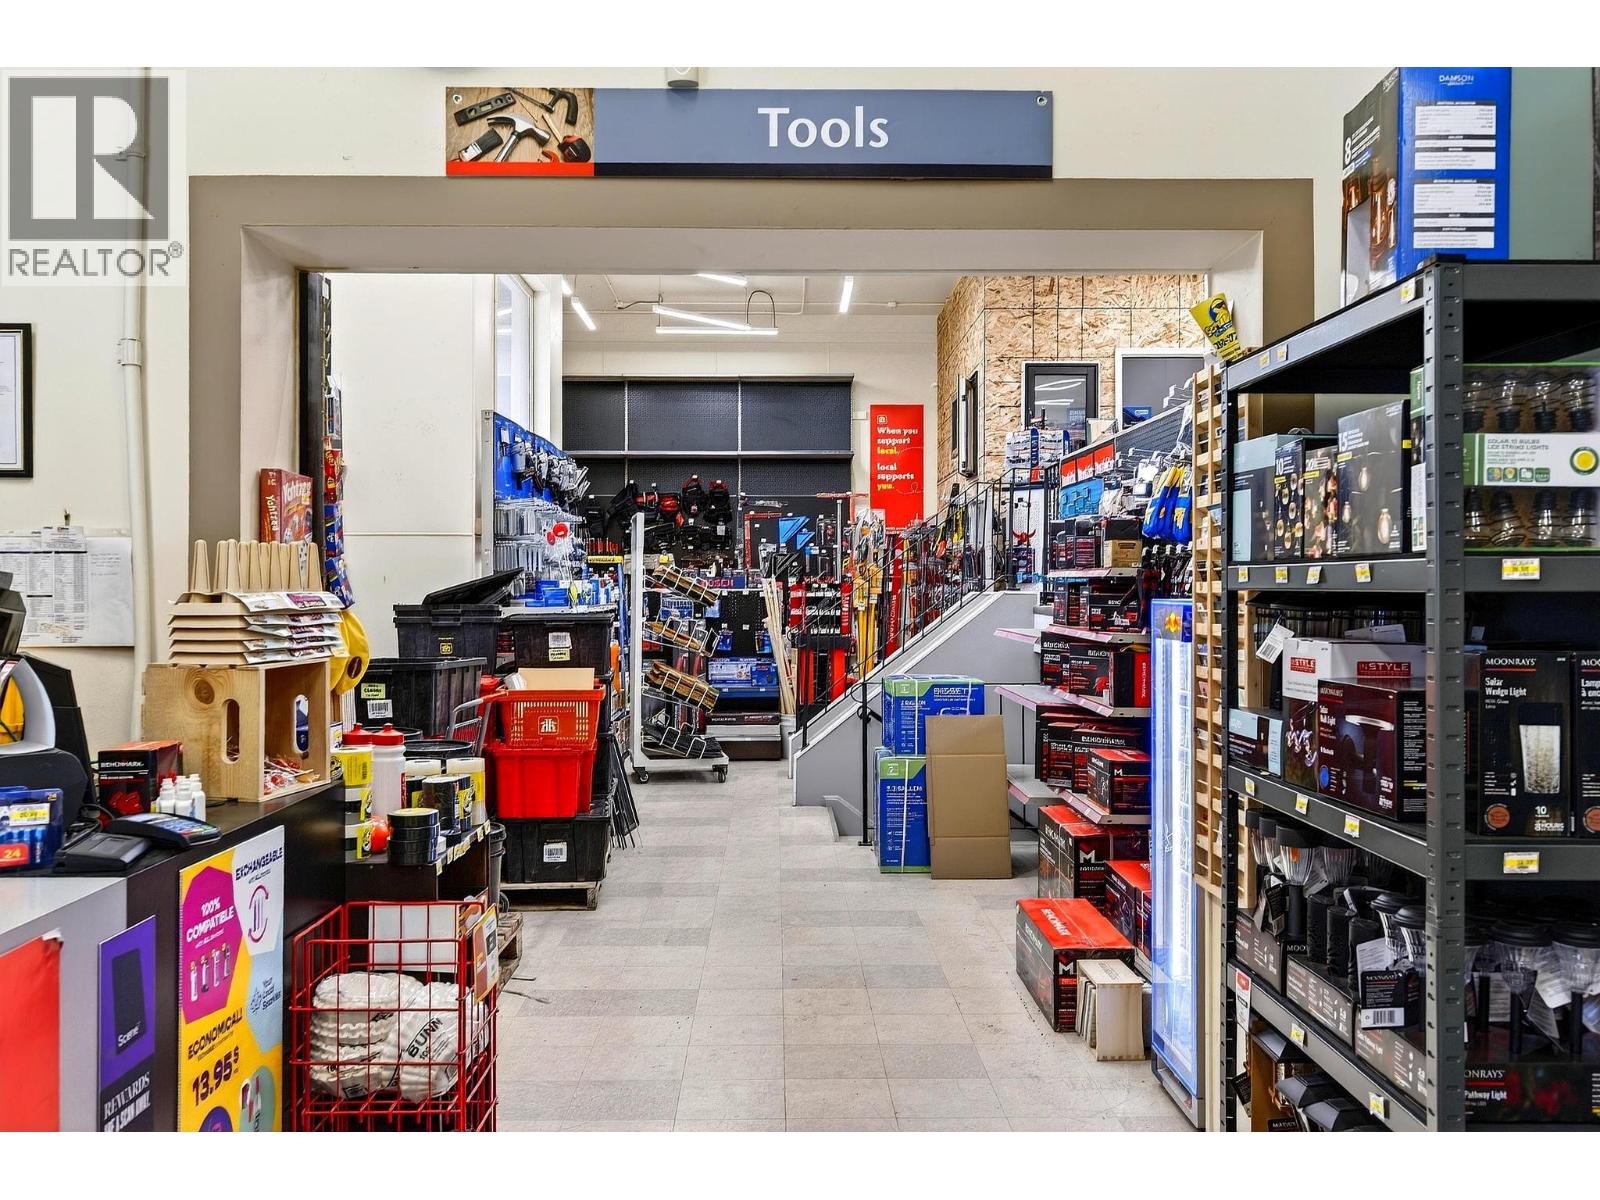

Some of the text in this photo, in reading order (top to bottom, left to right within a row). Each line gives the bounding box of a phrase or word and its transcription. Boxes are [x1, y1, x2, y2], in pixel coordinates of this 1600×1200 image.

[1439, 75, 1474, 83] DAMSON
[757, 106, 890, 148] Tools
[1344, 137, 1352, 165] 8
[877, 427, 901, 435] When
[877, 437, 910, 446] support
[877, 463, 897, 471] local
[877, 473, 914, 481] supports
[1360, 662, 1409, 671] INSTYLE
[1485, 658, 1536, 666] MOONRAYS
[1485, 677, 1503, 686] Solar
[1510, 687, 1527, 698] Light
[1535, 806, 1547, 815] 10
[4, 847, 22, 860] 24
[1080, 849, 1096, 864] M
[235, 847, 283, 881] EXCHANGEABLE
[201, 896, 222, 917] 100%
[186, 905, 235, 943] COMPATIBLE
[1058, 962, 1074, 975] M
[408, 1017, 443, 1058] BUNN
[104, 1071, 151, 1120] REWARDS
[1491, 1089, 1508, 1101] Light
